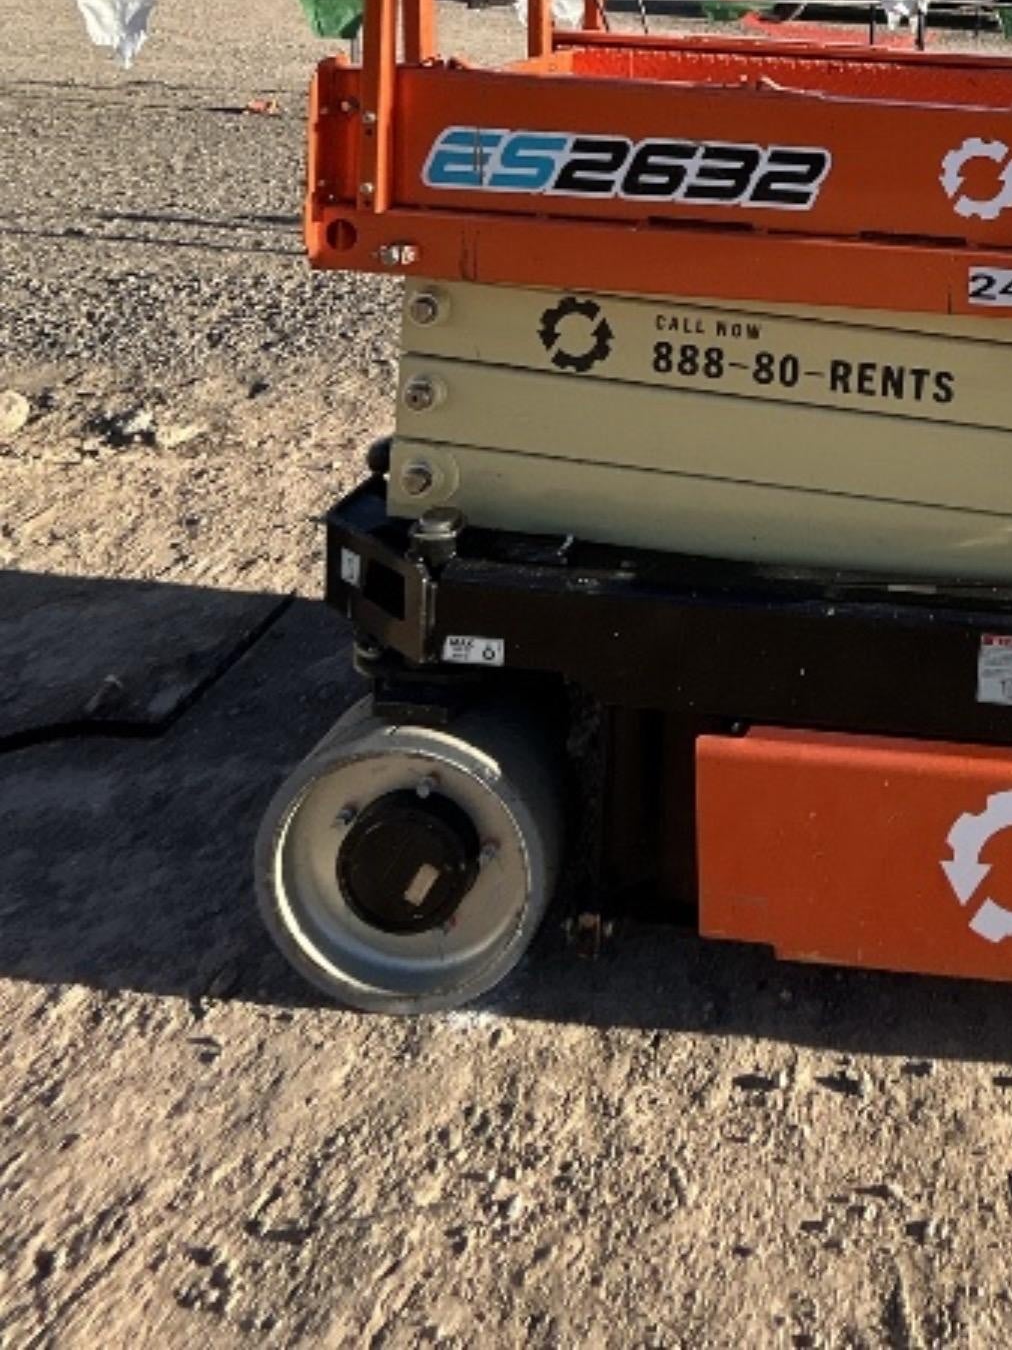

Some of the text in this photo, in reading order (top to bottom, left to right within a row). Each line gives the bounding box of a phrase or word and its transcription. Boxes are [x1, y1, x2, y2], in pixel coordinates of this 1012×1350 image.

[422, 125, 832, 210] ES2632
[655, 314, 761, 340] CALL NOW
[653, 340, 955, 403] 888-80-RENTS
